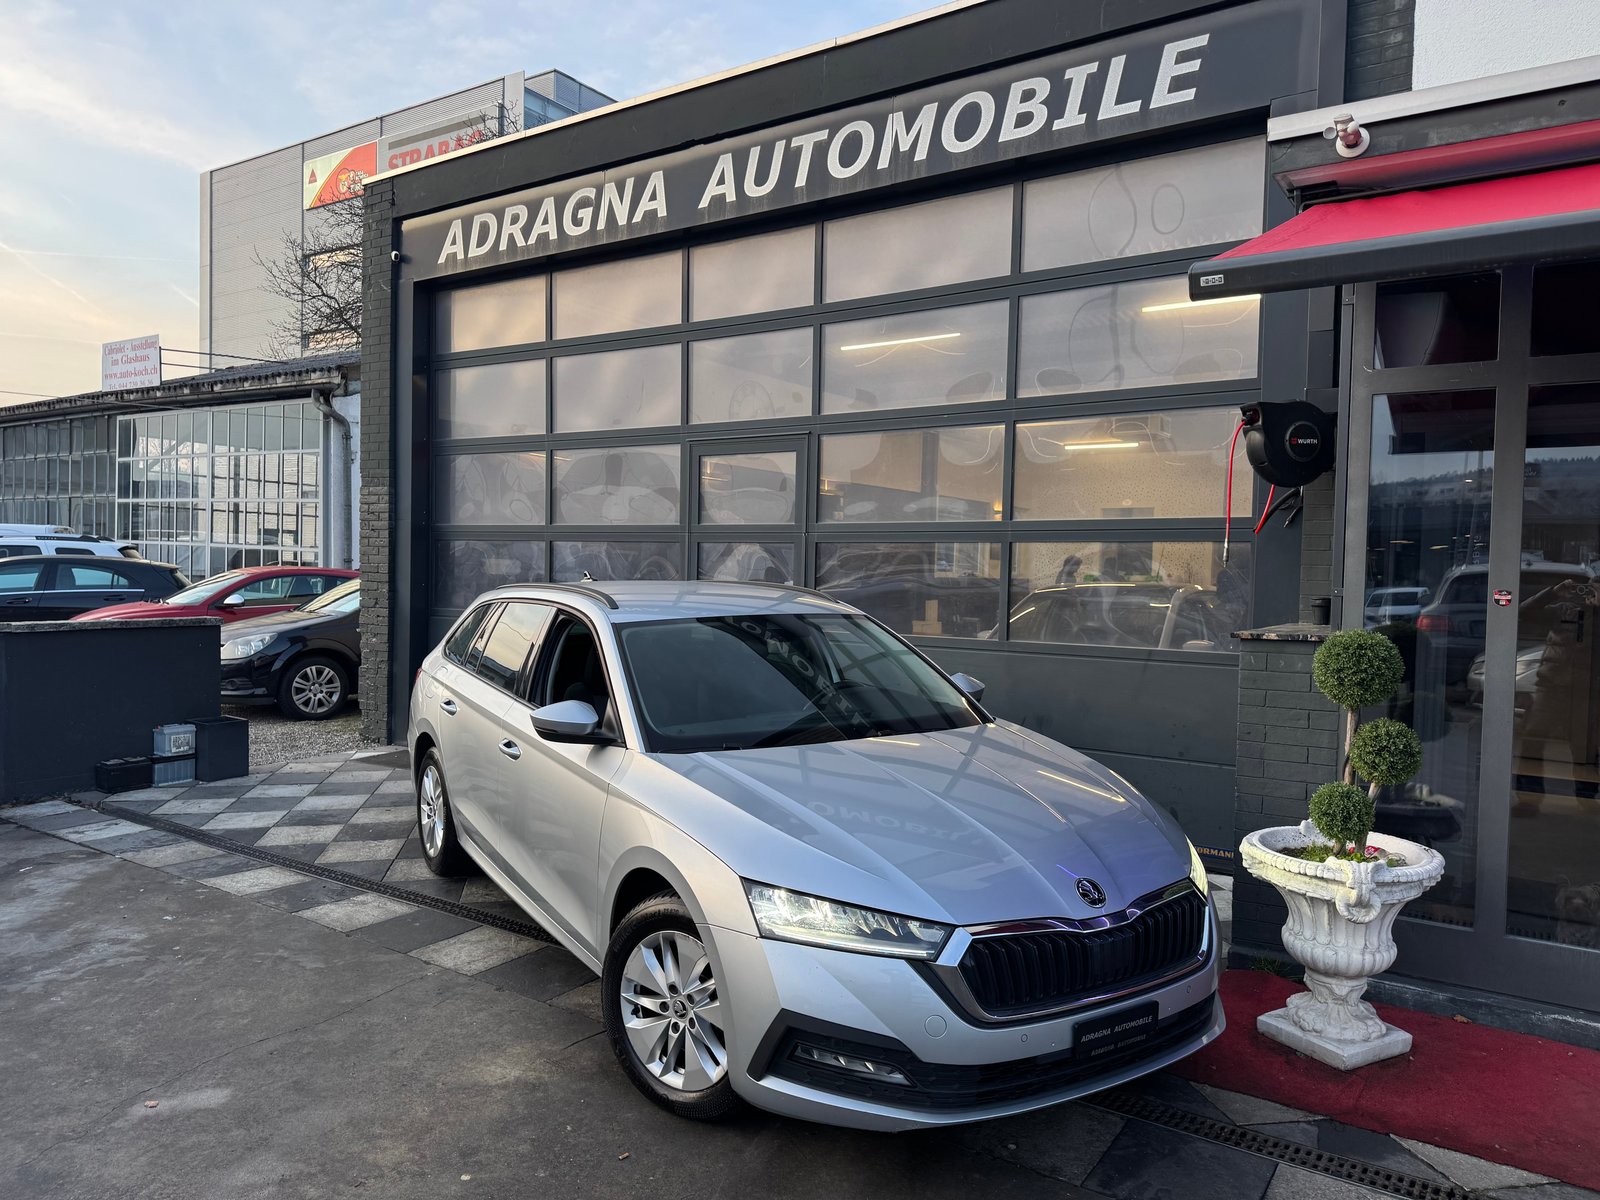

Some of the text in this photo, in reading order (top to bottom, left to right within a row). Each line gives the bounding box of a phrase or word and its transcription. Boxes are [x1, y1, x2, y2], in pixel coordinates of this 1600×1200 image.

[437, 33, 1210, 265] ADRAGNA AUTOMOBILE
[120, 353, 150, 365] Glashaus
[104, 364, 158, 380] www.auto-koch.ch
[1080, 1015, 1153, 1043] ADRAGNA AUTOMOBILE
